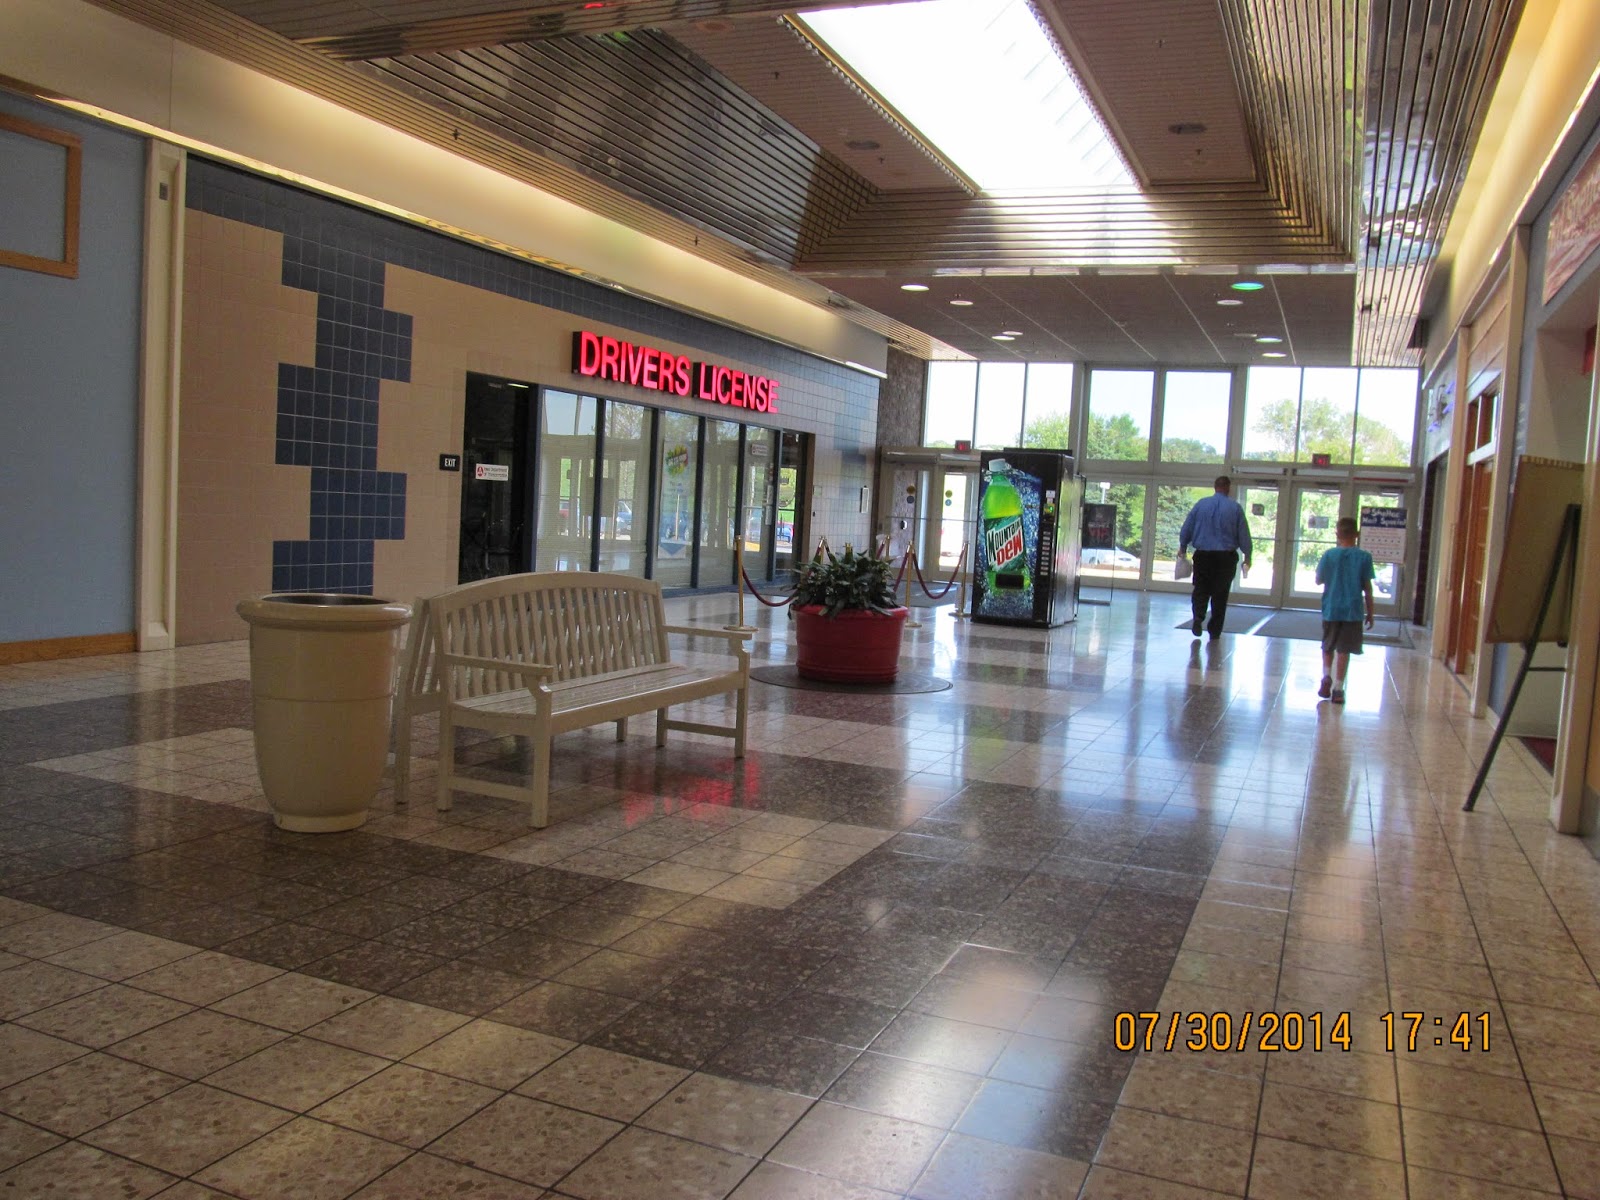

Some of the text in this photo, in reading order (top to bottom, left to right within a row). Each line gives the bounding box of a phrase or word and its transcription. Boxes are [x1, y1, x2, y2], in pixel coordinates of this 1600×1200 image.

[579, 331, 780, 414] DRIVERS LICENSE
[444, 457, 456, 468] EXIT
